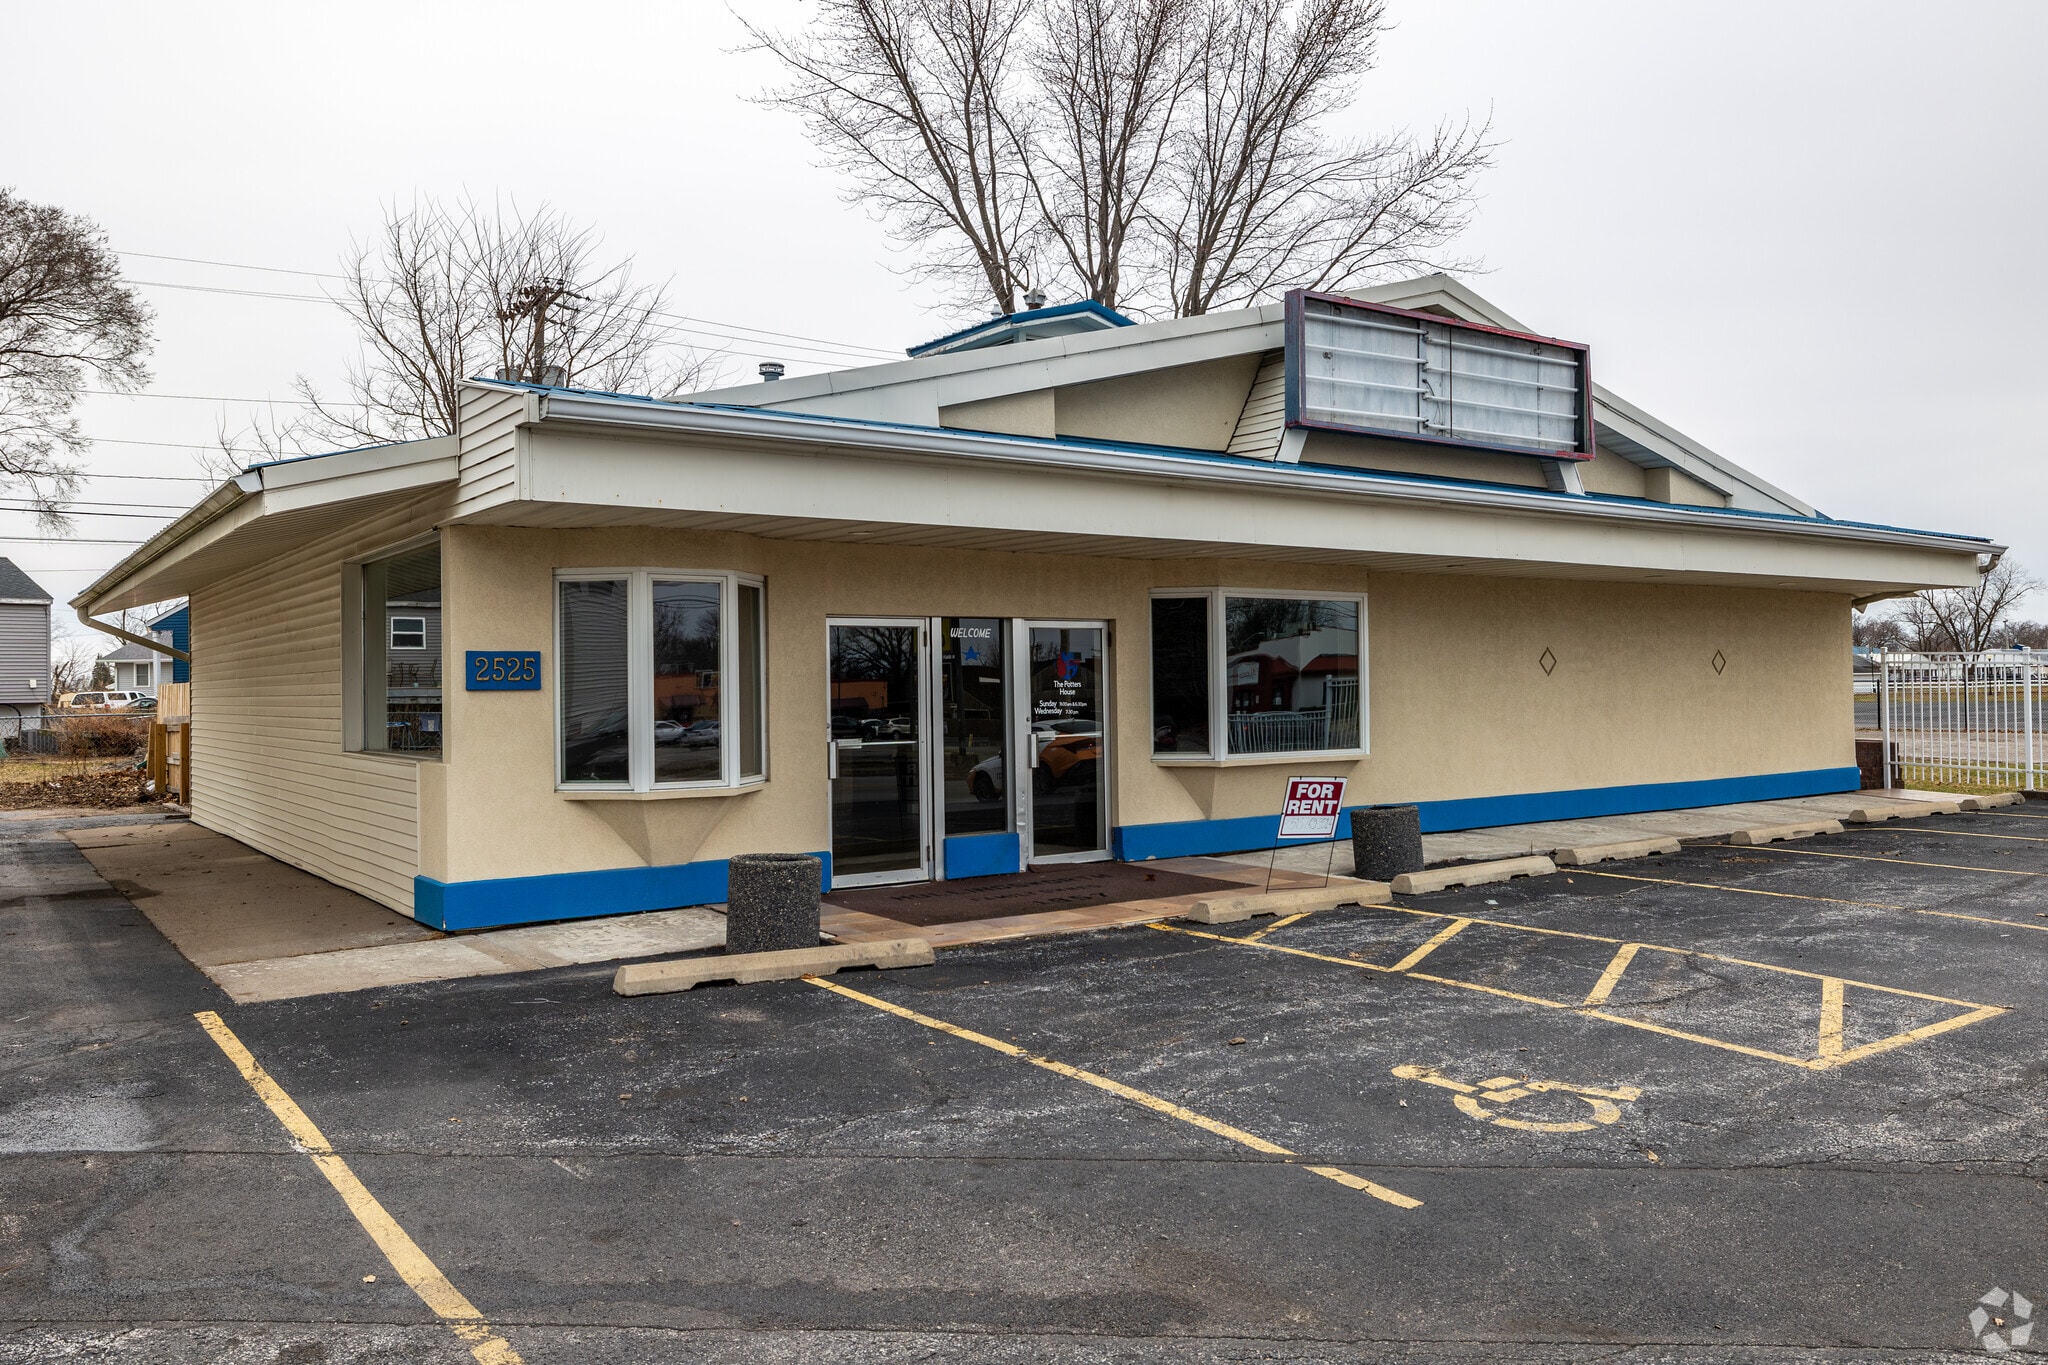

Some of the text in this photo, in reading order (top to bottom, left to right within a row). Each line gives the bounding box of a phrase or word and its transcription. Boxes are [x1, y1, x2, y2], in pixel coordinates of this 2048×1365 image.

[950, 627, 991, 638] WELCOME
[475, 657, 535, 681] 2525
[1053, 680, 1081, 688] The Potters
[1039, 700, 1057, 708] Sunday
[1034, 707, 1063, 716] Wednesday
[1296, 784, 1335, 799] FOR
[1286, 800, 1338, 815] RENT
